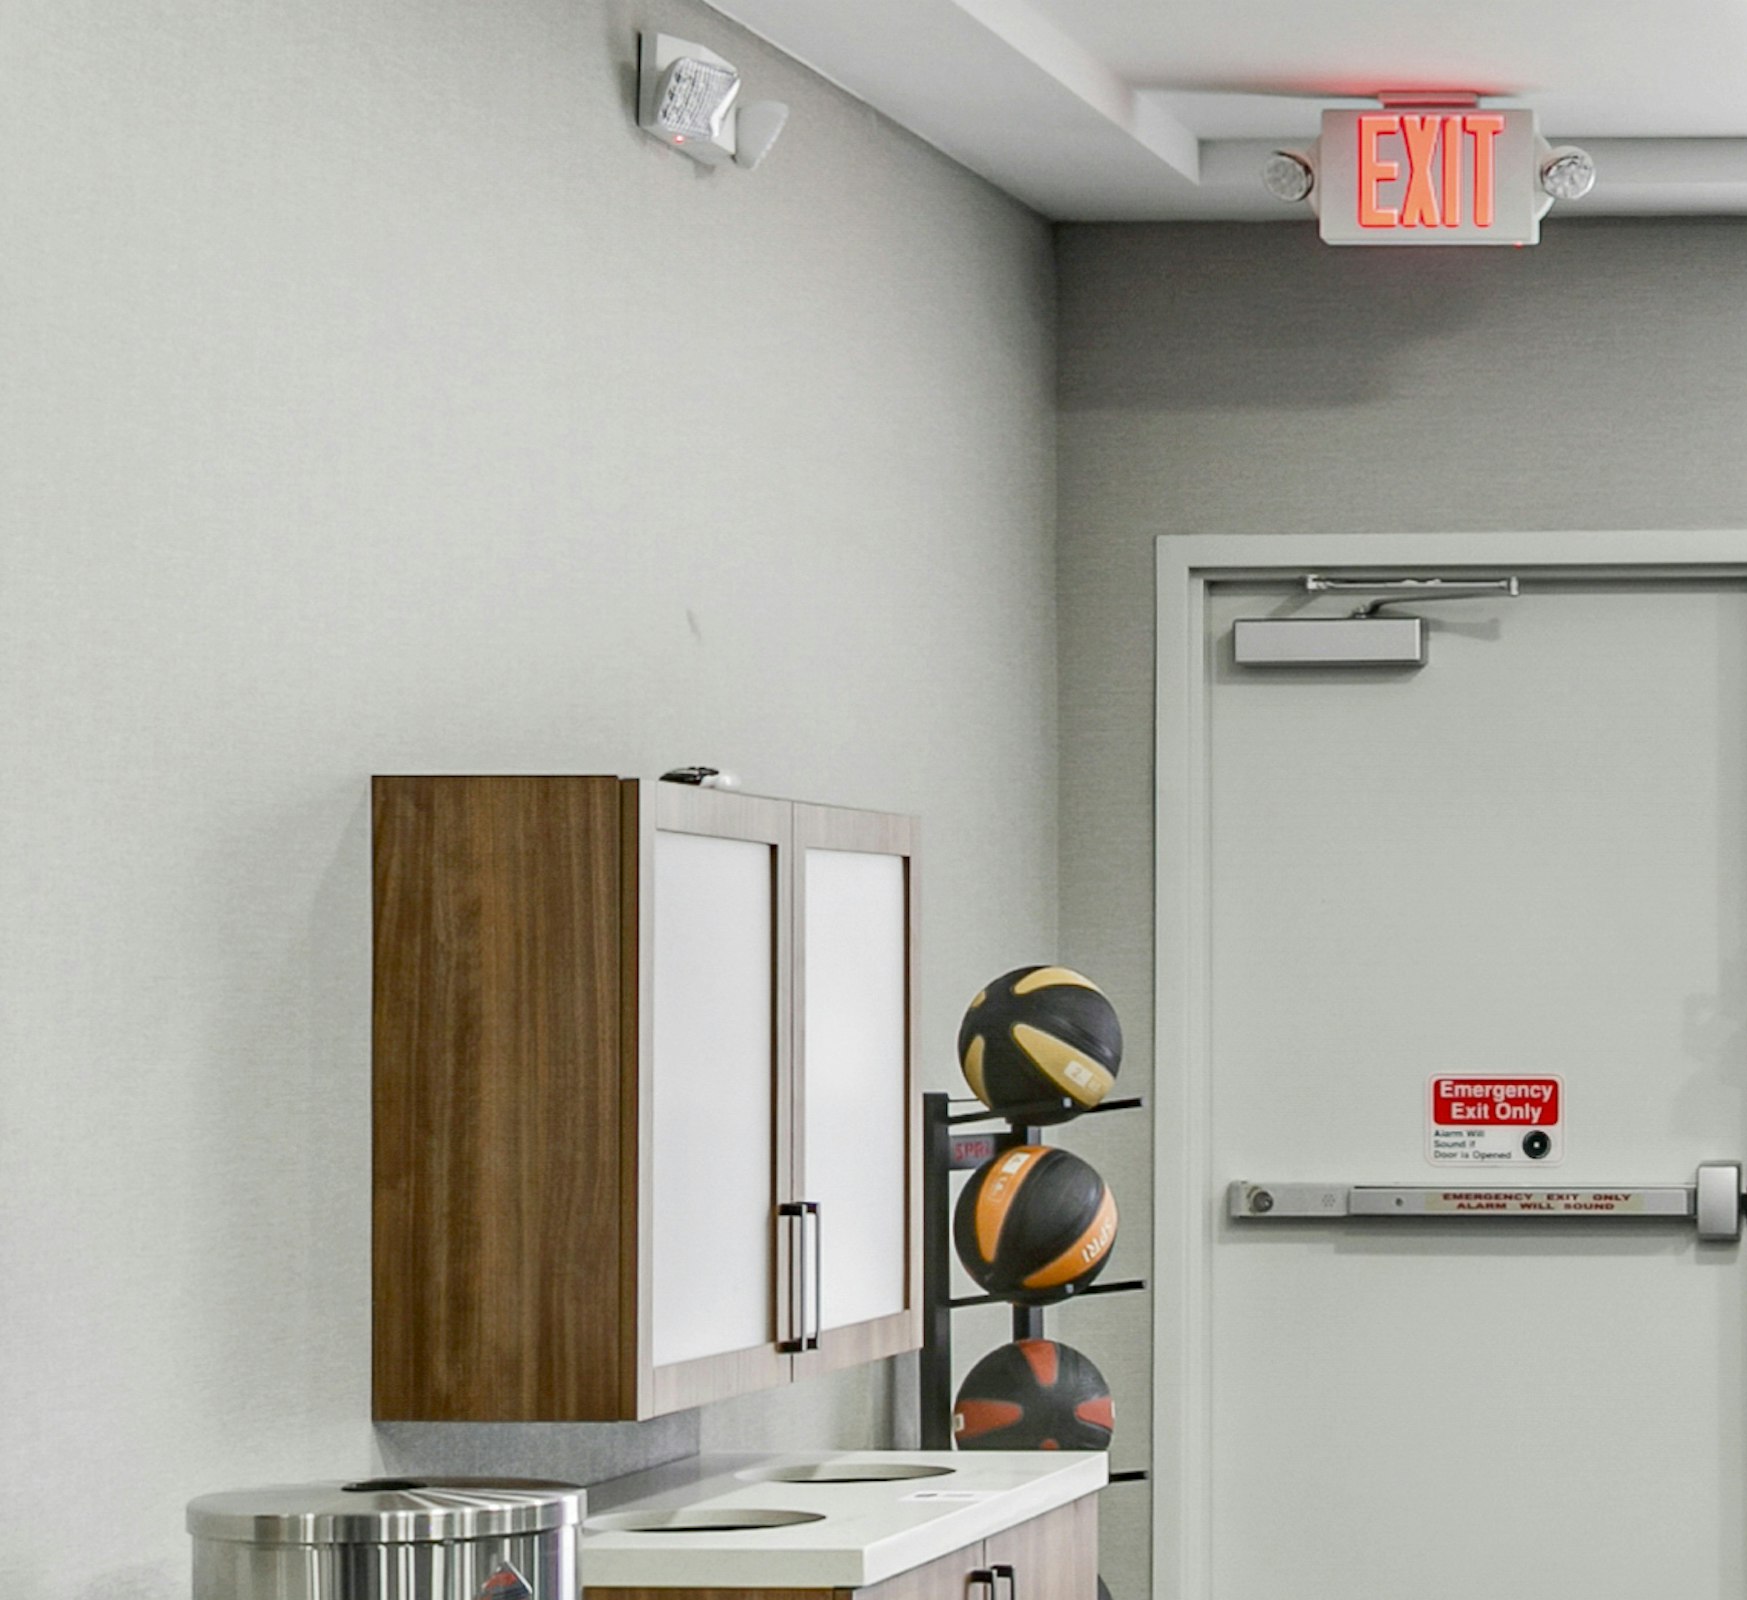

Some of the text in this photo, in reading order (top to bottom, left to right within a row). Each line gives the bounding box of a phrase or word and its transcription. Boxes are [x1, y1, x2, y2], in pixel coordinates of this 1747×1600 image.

[1357, 114, 1505, 229] EXIT
[1439, 1080, 1553, 1102] Emergency
[1451, 1102, 1542, 1124] Exit Only
[1443, 1192, 1632, 1201] EMERGENCY EXIT ONLY
[1456, 1202, 1615, 1210] ALARM WILL SOUND
